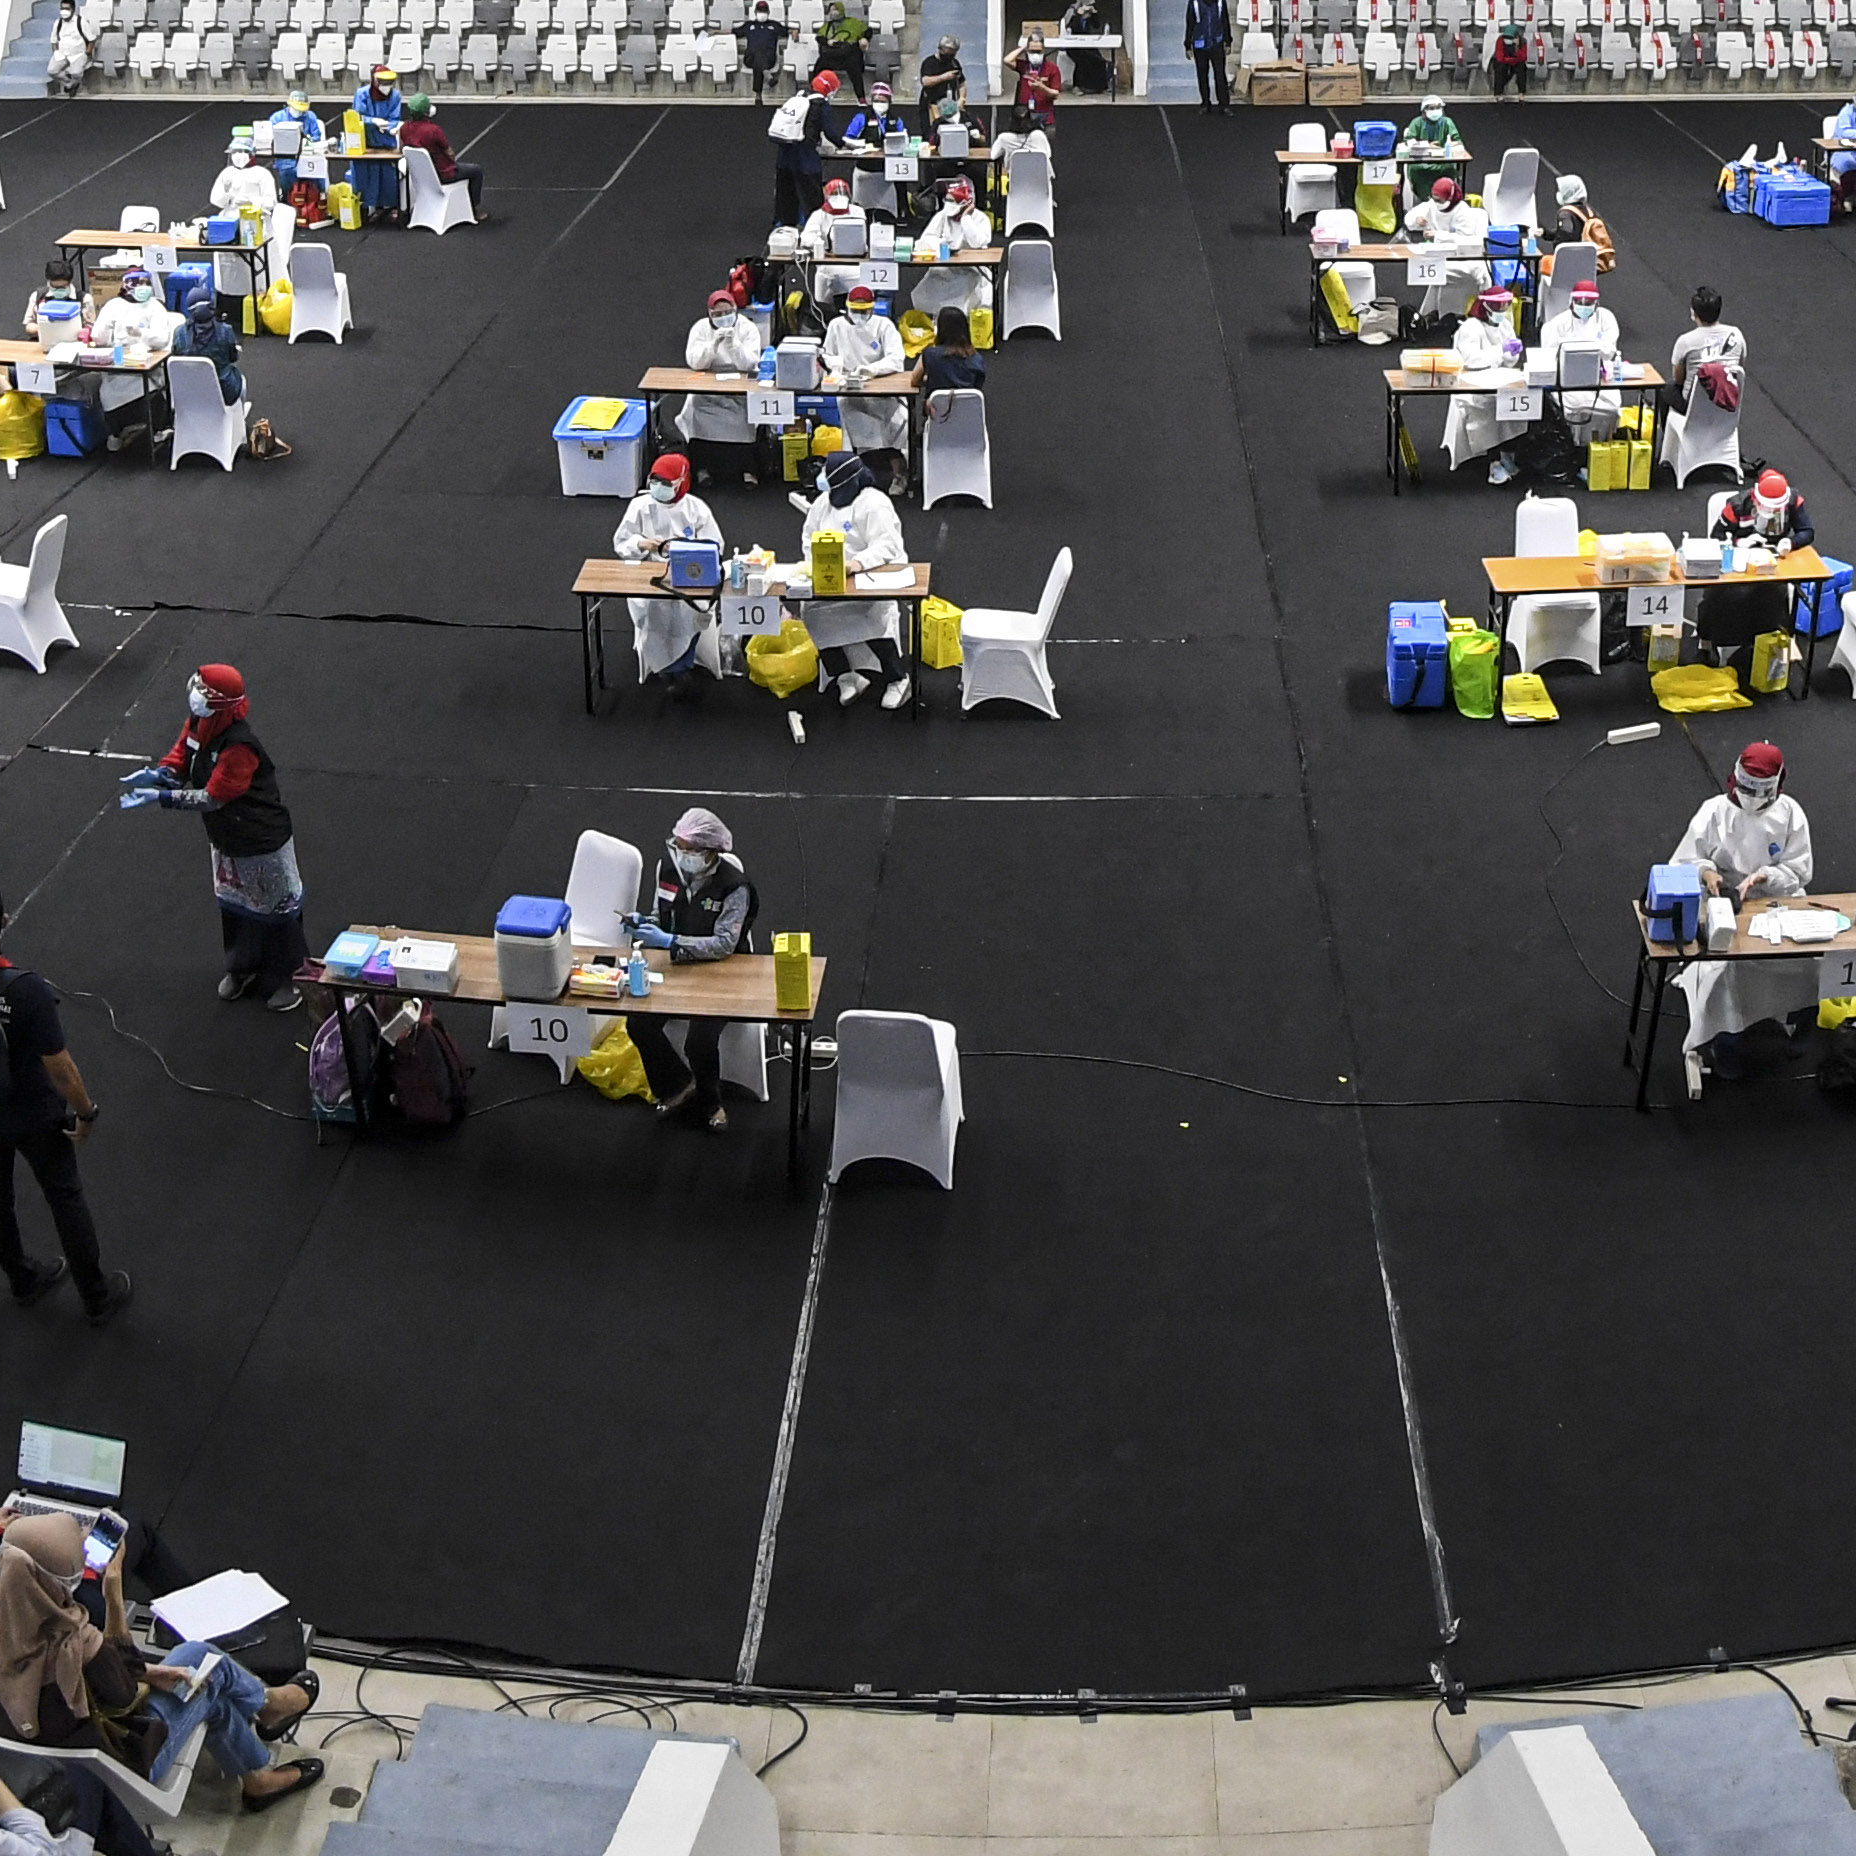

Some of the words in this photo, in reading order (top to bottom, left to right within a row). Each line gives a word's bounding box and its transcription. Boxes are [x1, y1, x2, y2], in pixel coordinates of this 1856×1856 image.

[307, 161, 315, 172] 9
[895, 163, 909, 176] 13
[1372, 166, 1387, 179] 17
[156, 253, 164, 265] 8
[870, 269, 888, 283] 12
[1419, 265, 1436, 278] 16
[30, 369, 40, 384] 7
[760, 400, 782, 415] 11
[1509, 396, 1530, 412] 15
[1642, 595, 1669, 616] 14
[737, 605, 765, 626] 10
[530, 1017, 570, 1043] 10
